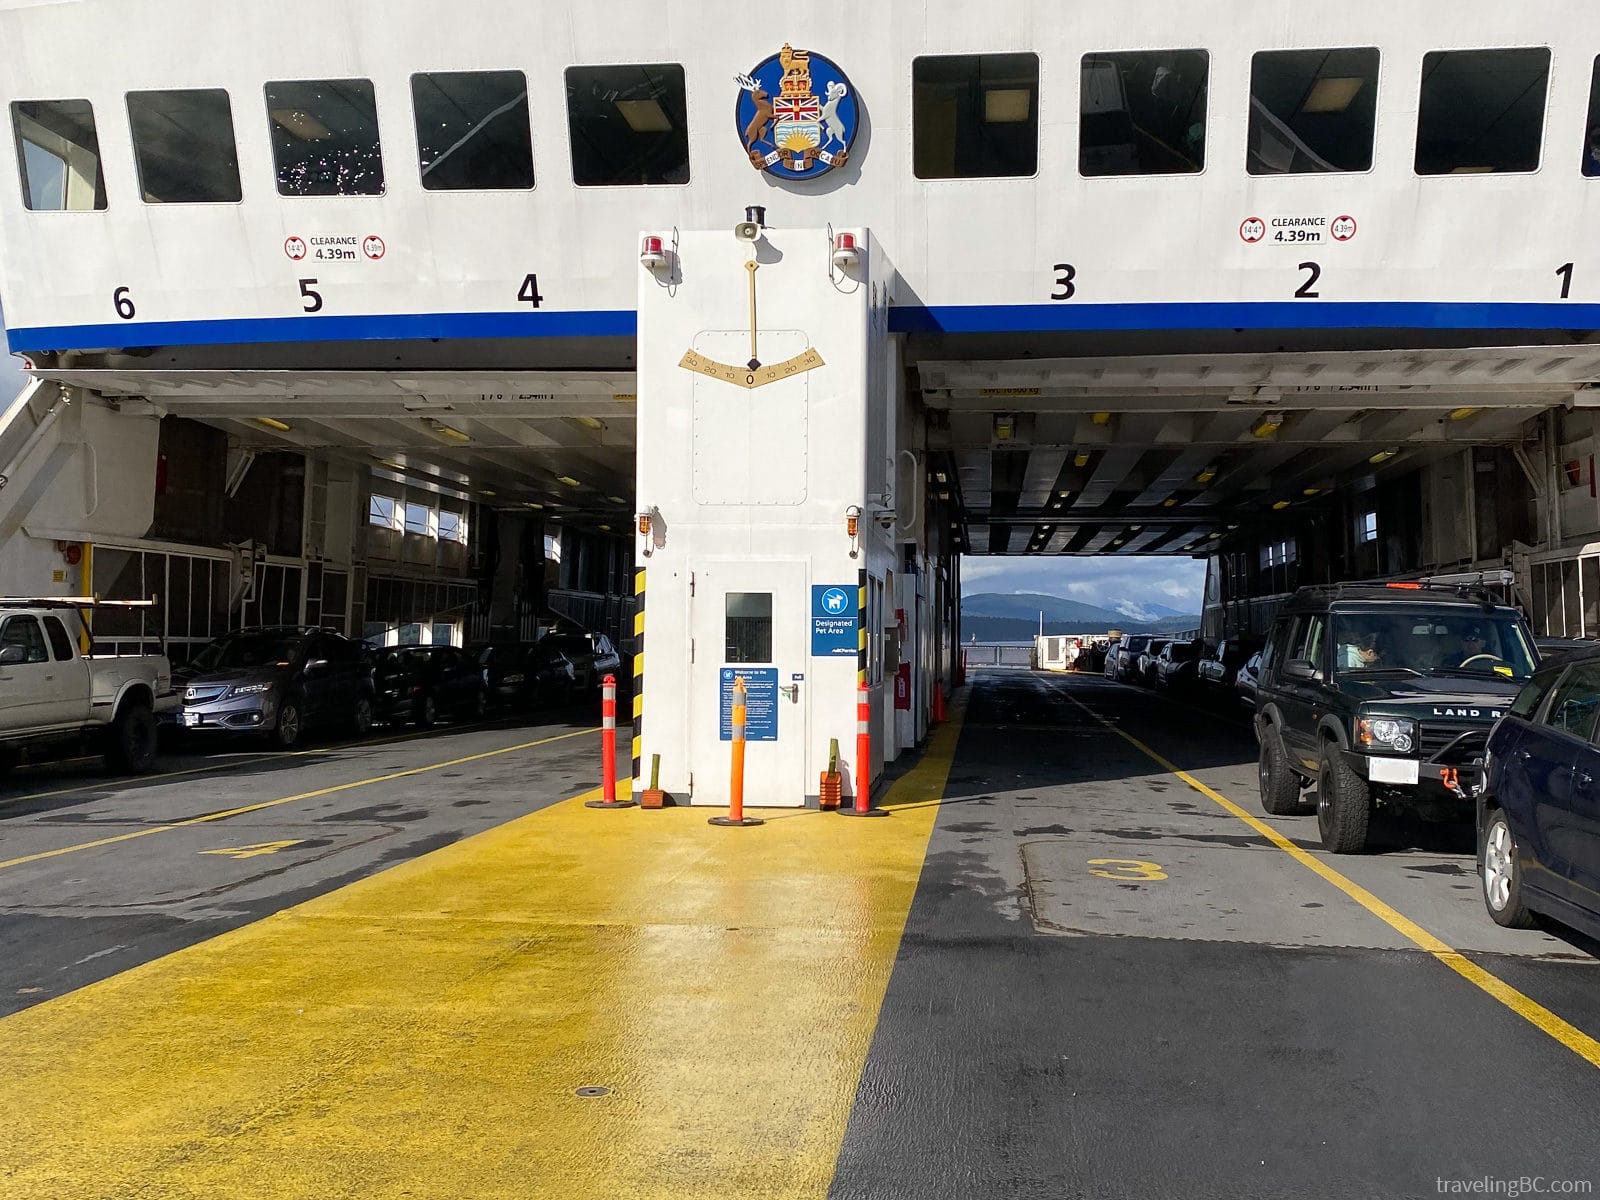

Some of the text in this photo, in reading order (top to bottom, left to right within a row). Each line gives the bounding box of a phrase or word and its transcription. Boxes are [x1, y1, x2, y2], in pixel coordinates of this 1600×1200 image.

[1271, 217, 1326, 227] CLEARANCE
[310, 236, 357, 246] CLEARANCE
[1274, 230, 1321, 242] 4.39m
[315, 248, 356, 260] 4.39m
[517, 273, 544, 308] 4
[1050, 263, 1076, 301] 3
[1294, 261, 1321, 298] 2
[1555, 262, 1574, 299] 1
[113, 286, 136, 320] 6
[298, 278, 323, 313] 5
[684, 355, 816, 385] 30 20 10 0 10 20 30
[815, 619, 853, 629] Designated
[1433, 708, 1480, 717] LAND
[196, 839, 306, 859] 4
[1086, 858, 1169, 881] 3
